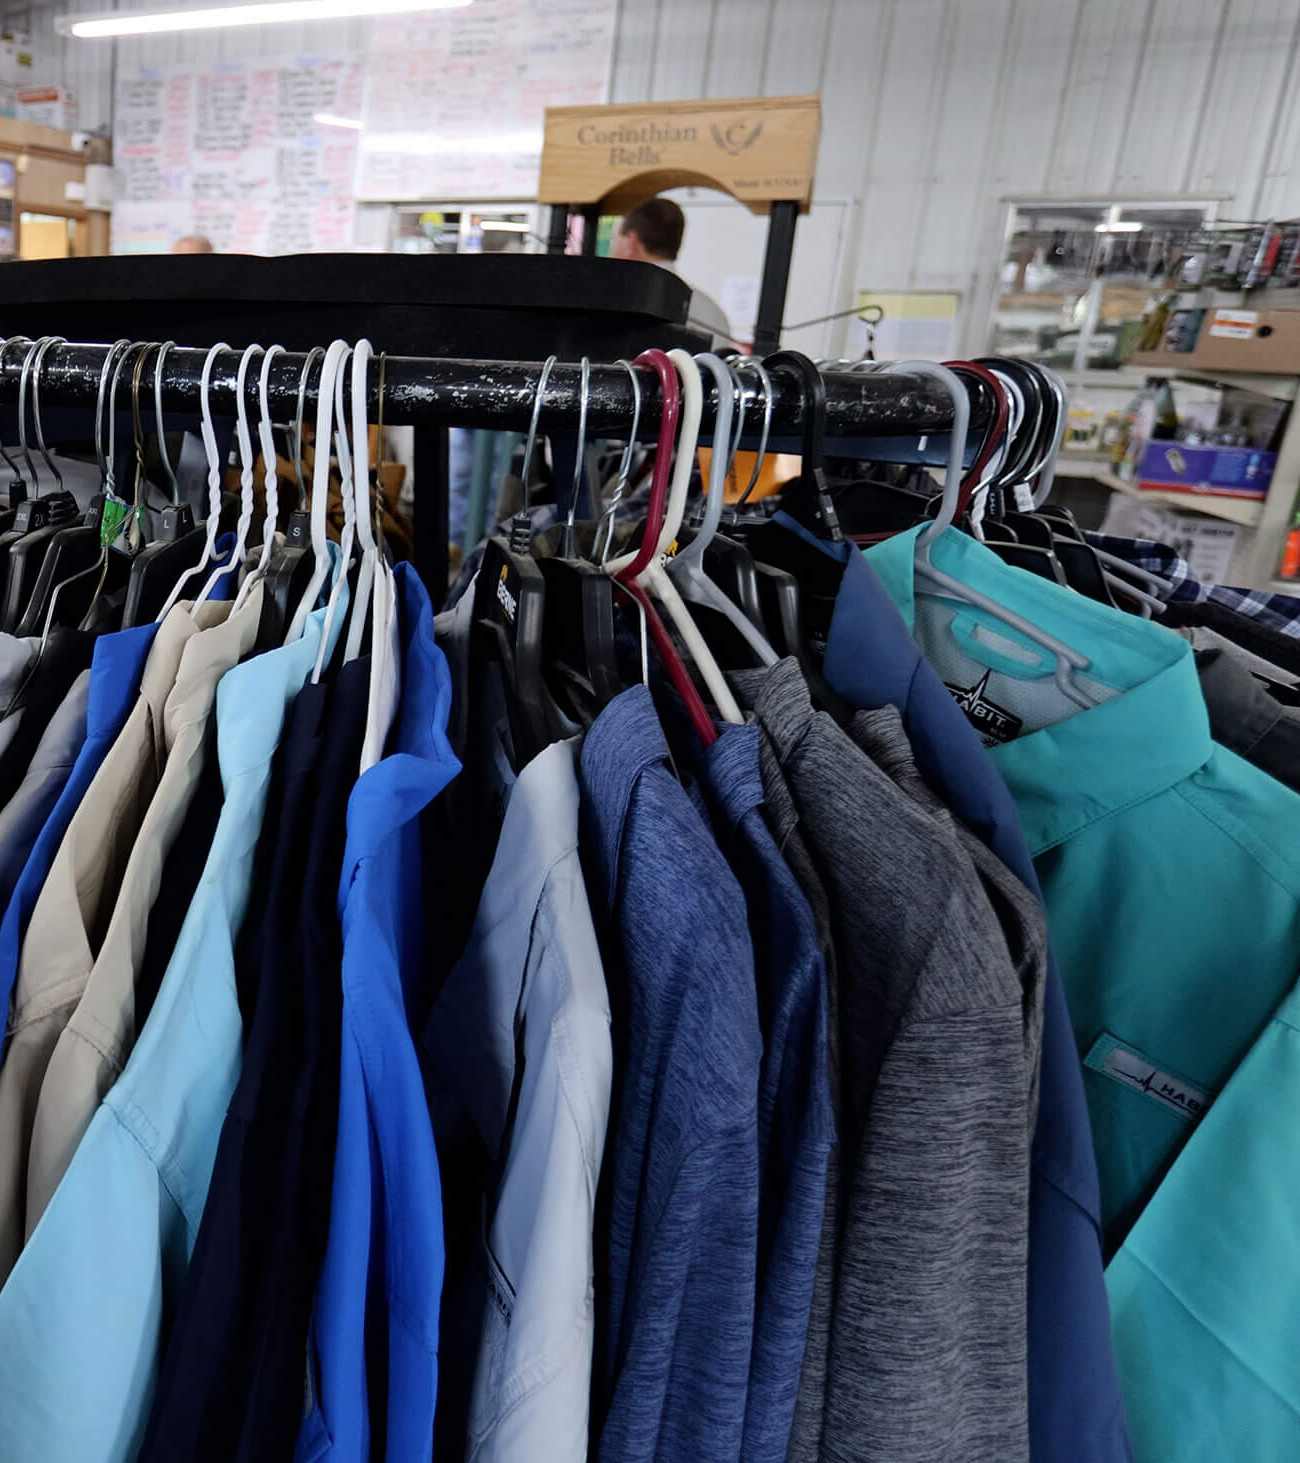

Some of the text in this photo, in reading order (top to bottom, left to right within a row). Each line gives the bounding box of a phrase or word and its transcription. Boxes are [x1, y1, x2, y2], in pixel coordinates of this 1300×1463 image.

[577, 122, 698, 145] Corinthian
[609, 146, 661, 166] Bells
[292, 527, 301, 537] S
[496, 579, 517, 621] BERNE
[953, 695, 1007, 727] ABIT
[1160, 1084, 1202, 1111] HAB
